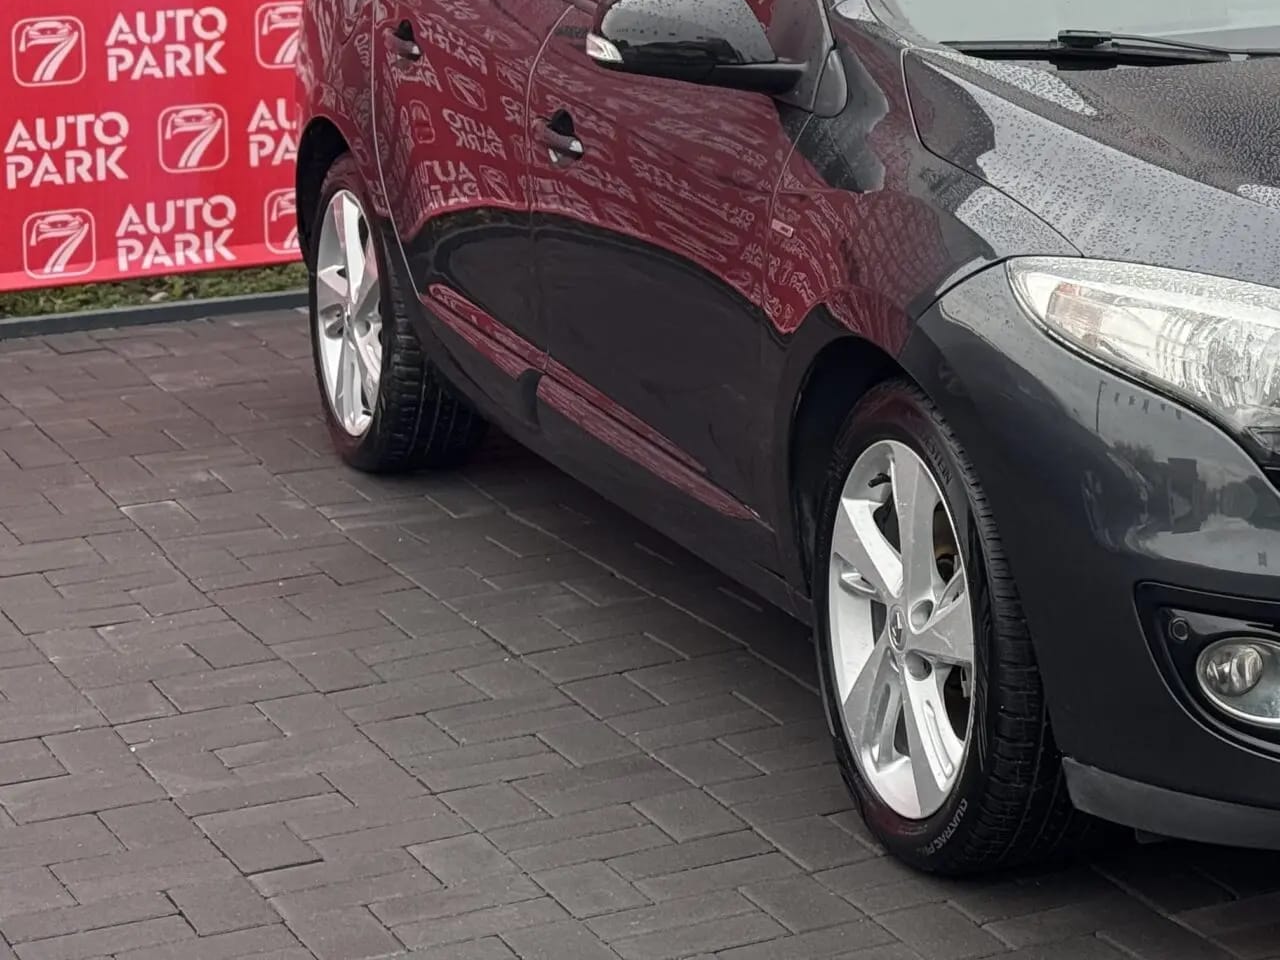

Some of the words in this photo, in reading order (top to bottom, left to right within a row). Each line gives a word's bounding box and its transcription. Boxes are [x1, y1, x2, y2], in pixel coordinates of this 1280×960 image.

[106, 7, 227, 46] AUTO
[108, 41, 225, 81] PARK
[5, 112, 129, 153] AUTO
[7, 146, 127, 189] PARK
[116, 195, 236, 236] AUTO
[118, 229, 236, 272] PARK
